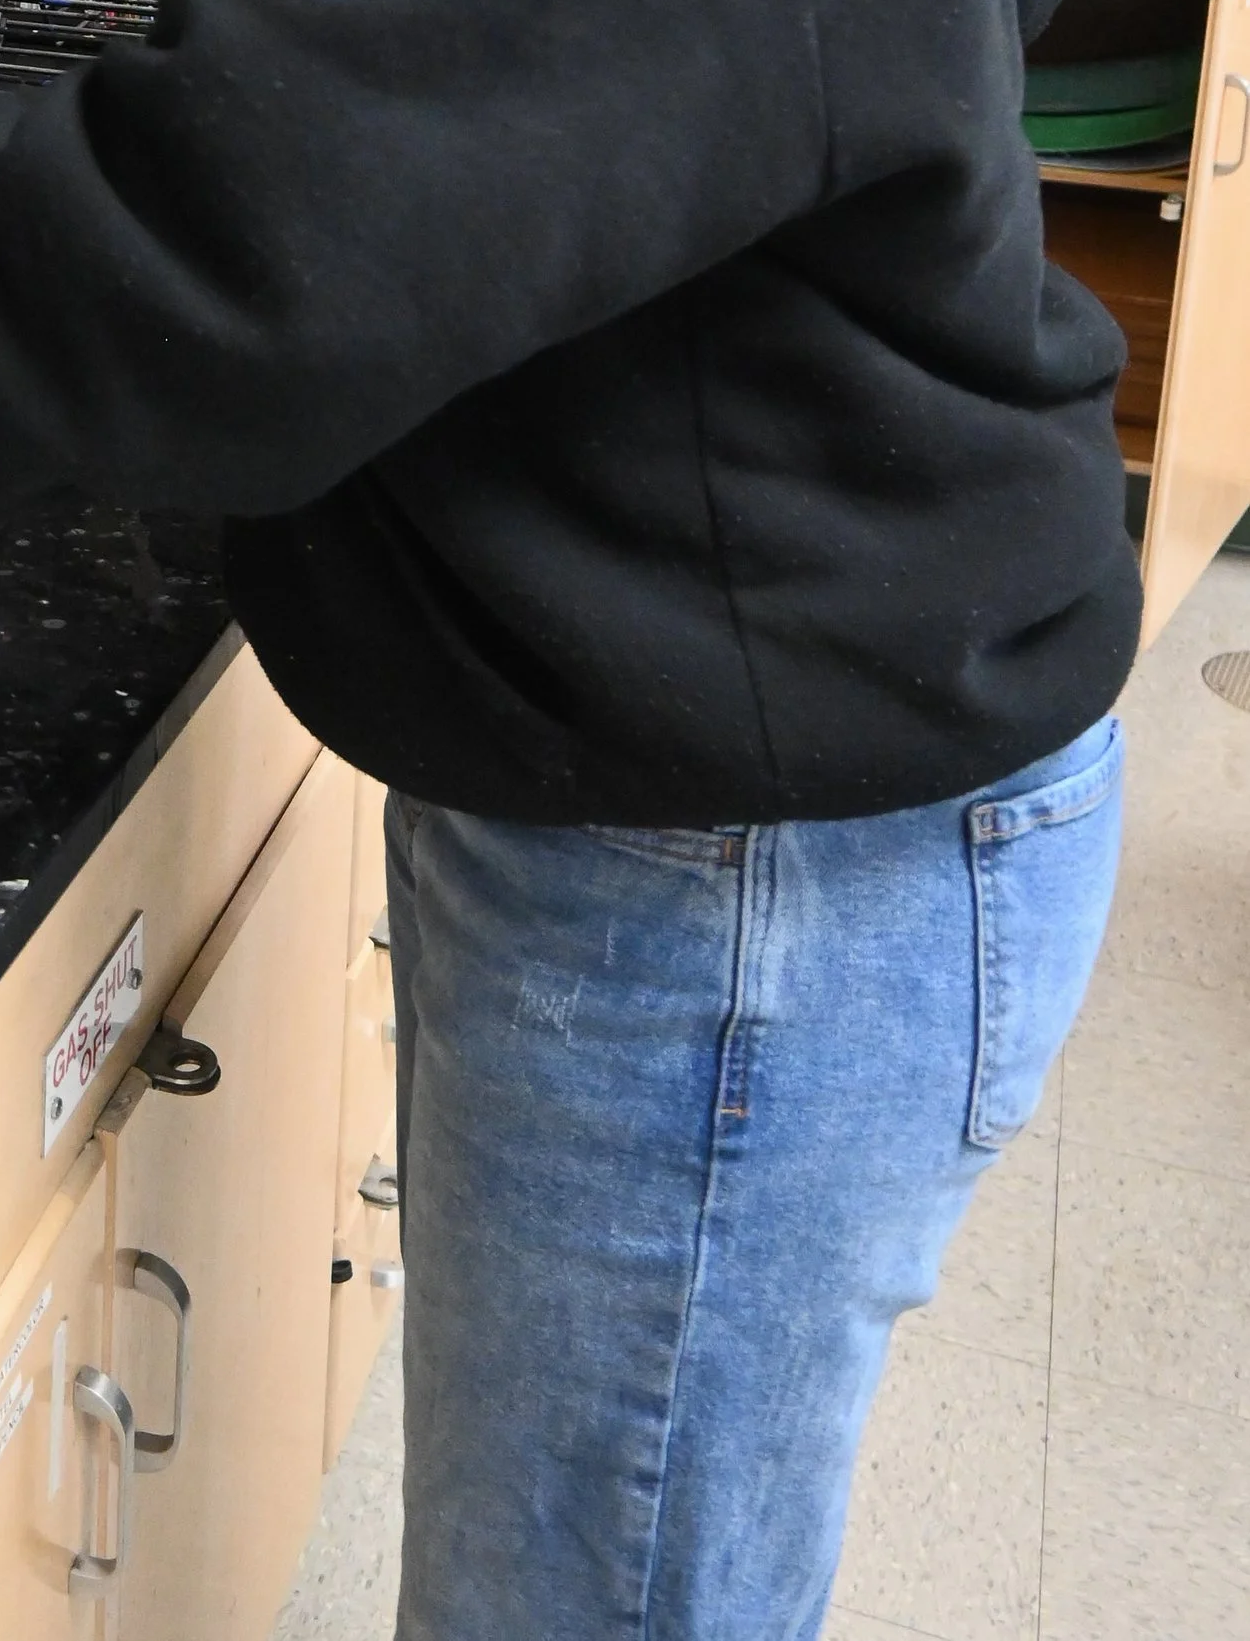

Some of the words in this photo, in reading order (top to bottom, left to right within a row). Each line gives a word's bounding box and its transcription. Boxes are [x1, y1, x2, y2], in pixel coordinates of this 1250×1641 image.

[53, 1013, 88, 1088] GAS
[94, 935, 137, 1027] SHUT
[80, 1012, 112, 1086] OFF
